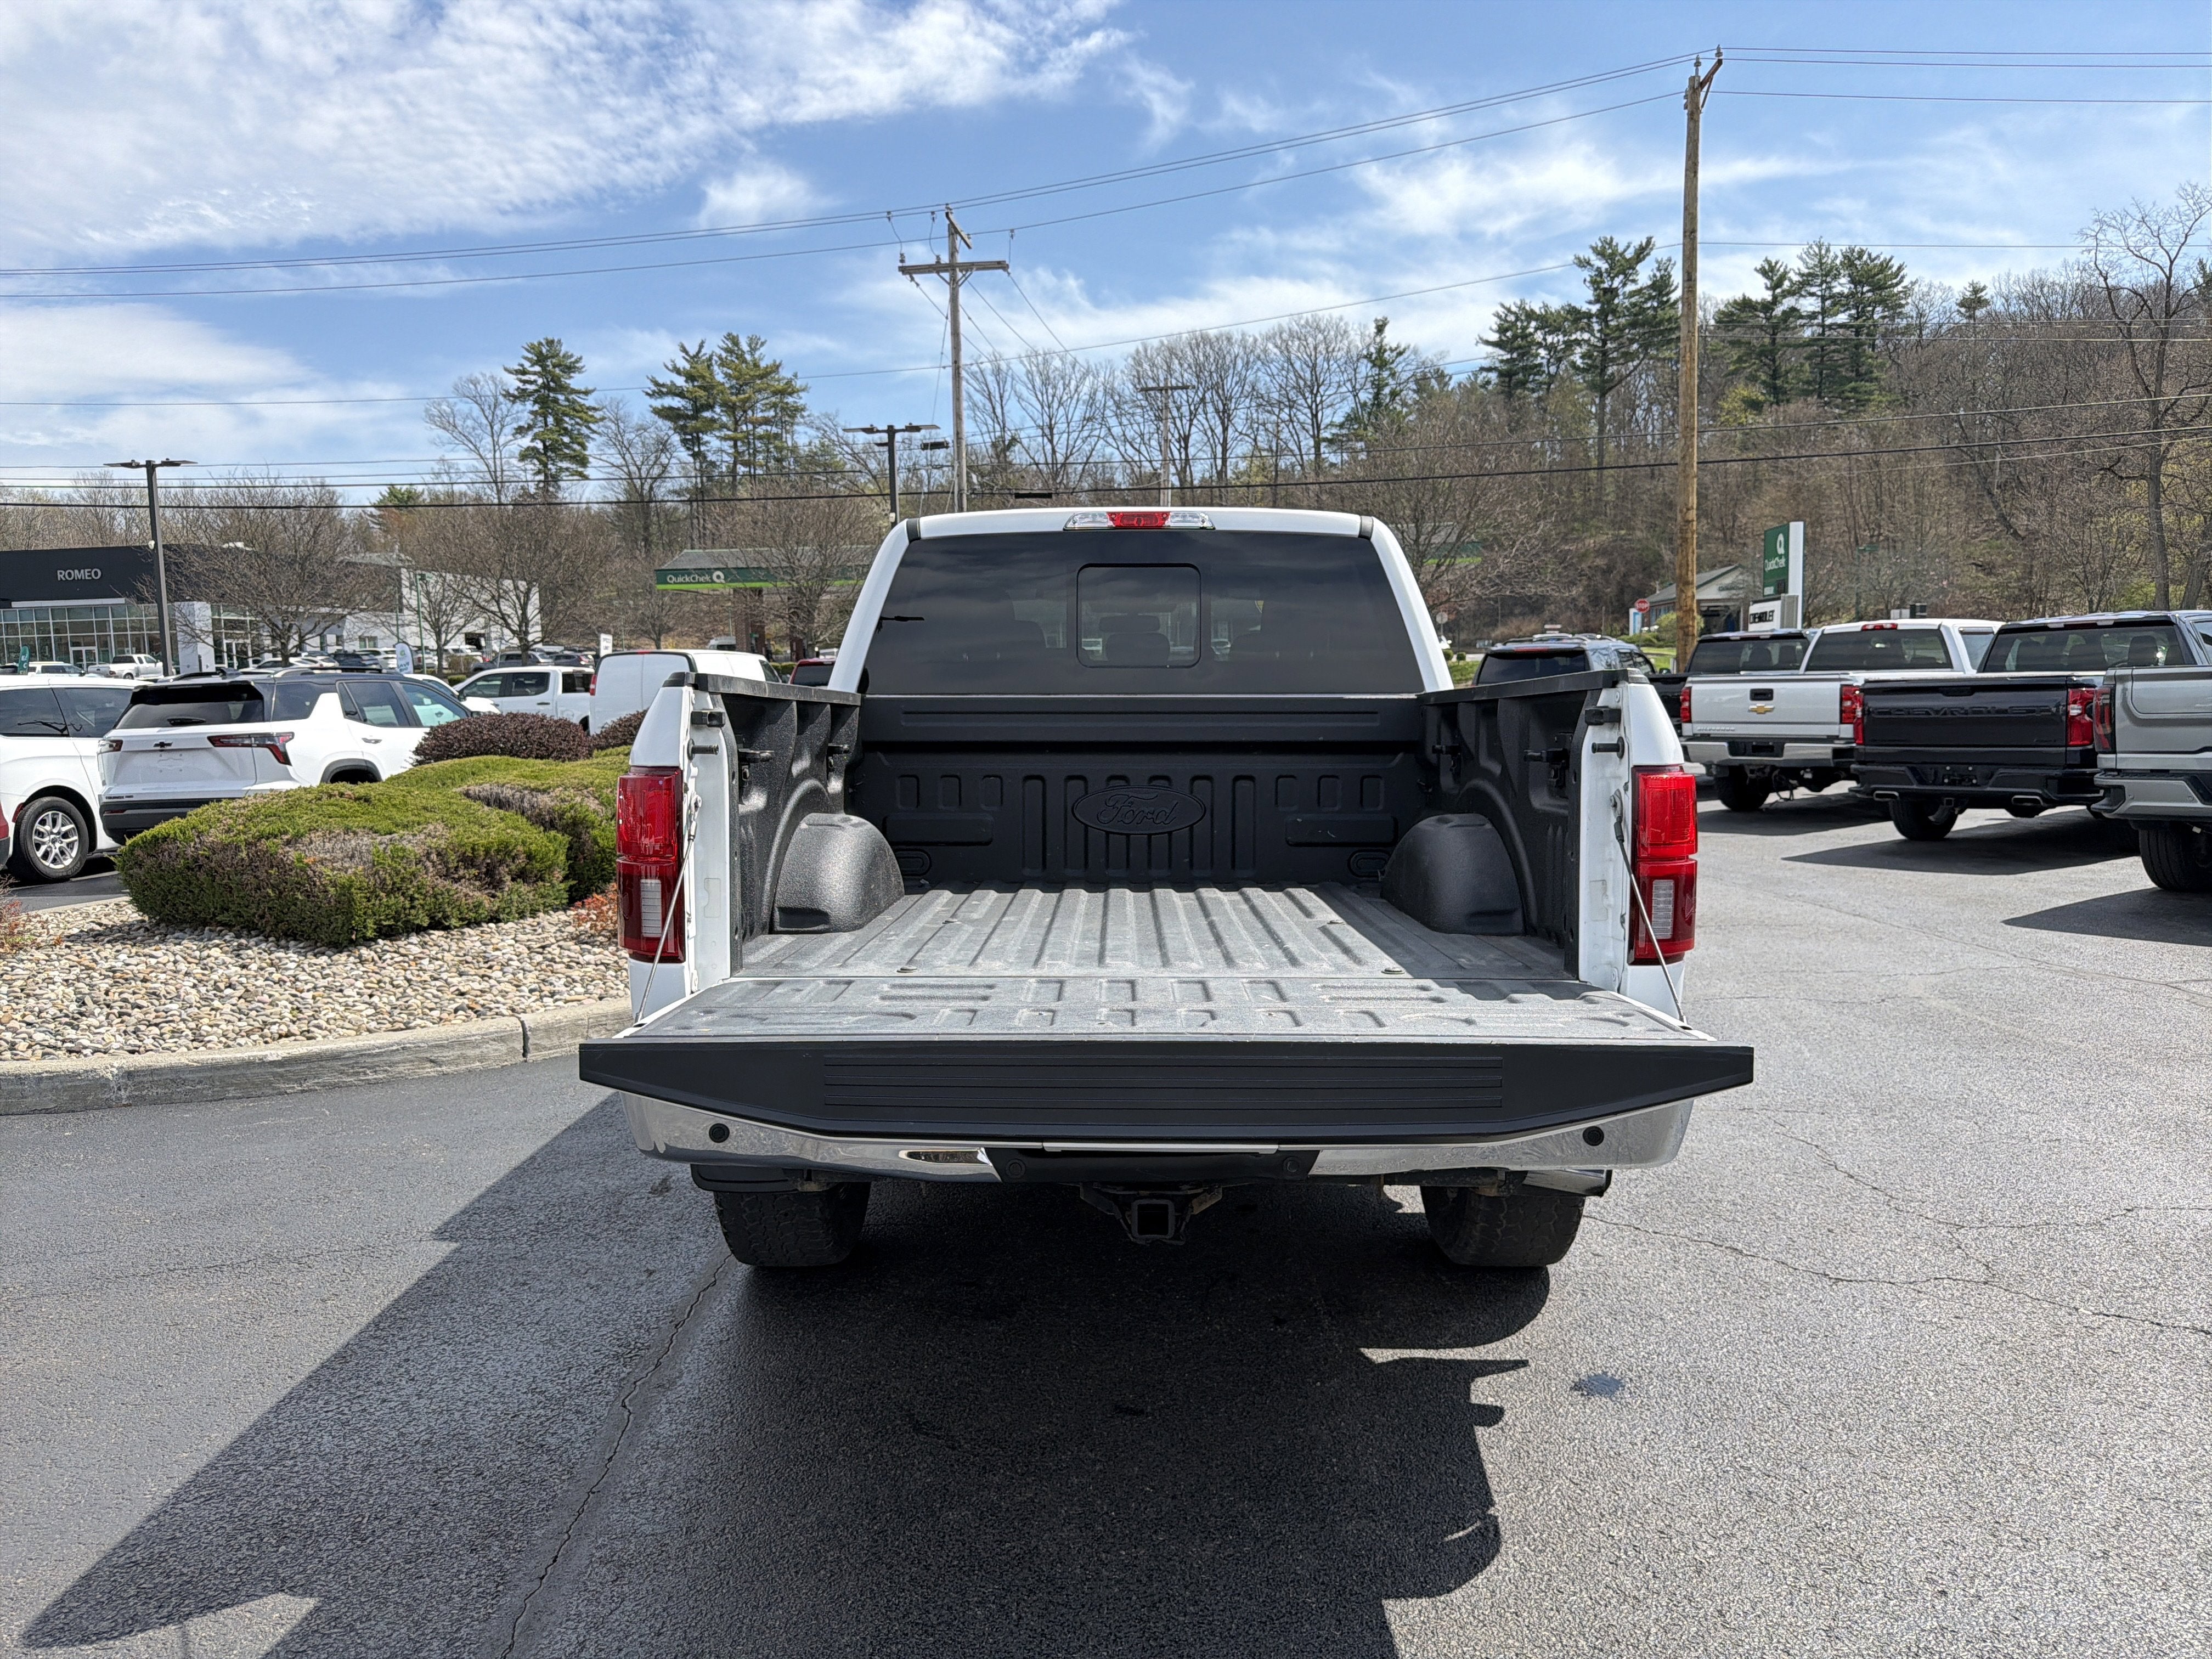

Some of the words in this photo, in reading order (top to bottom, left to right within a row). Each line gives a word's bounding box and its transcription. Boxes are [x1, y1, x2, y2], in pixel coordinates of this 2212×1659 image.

[57, 568, 101, 580] ROMEO
[667, 574, 712, 584] QuickChek
[1097, 793, 1178, 825] Ford
